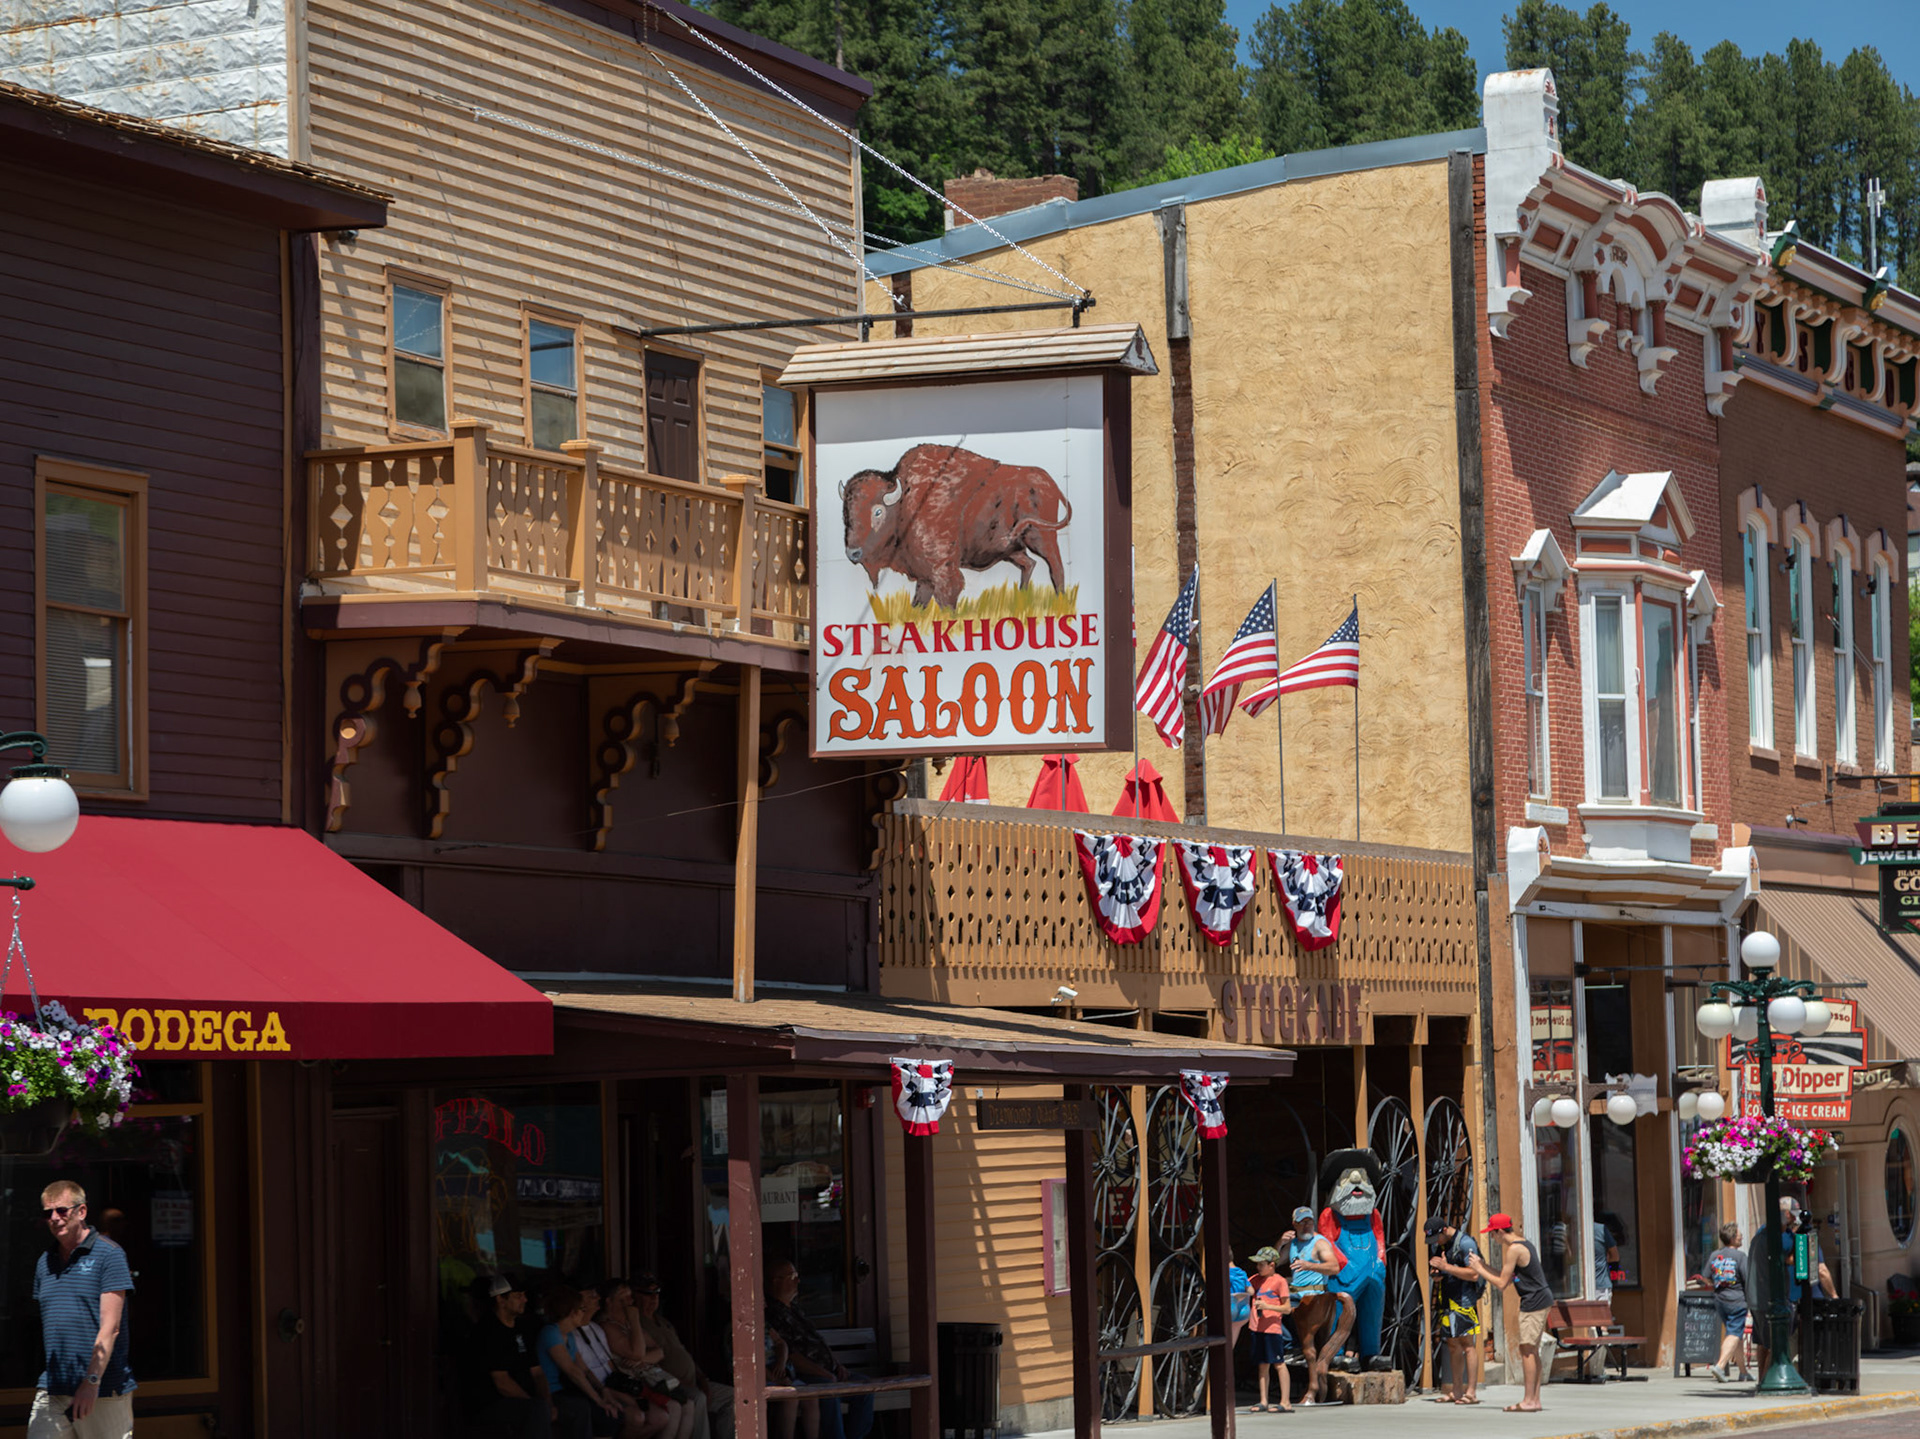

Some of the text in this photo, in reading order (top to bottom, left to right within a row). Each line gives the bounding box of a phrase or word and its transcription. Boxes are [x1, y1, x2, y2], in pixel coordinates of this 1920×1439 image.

[823, 613, 1100, 657] STEAKHOUSE
[827, 657, 1095, 743] SALOON
[1222, 980, 1362, 1040] STOCKADE
[1783, 1067, 1844, 1093] Dipper
[1793, 1105, 1808, 1117] ICE
[1811, 1105, 1846, 1117] CREAM
